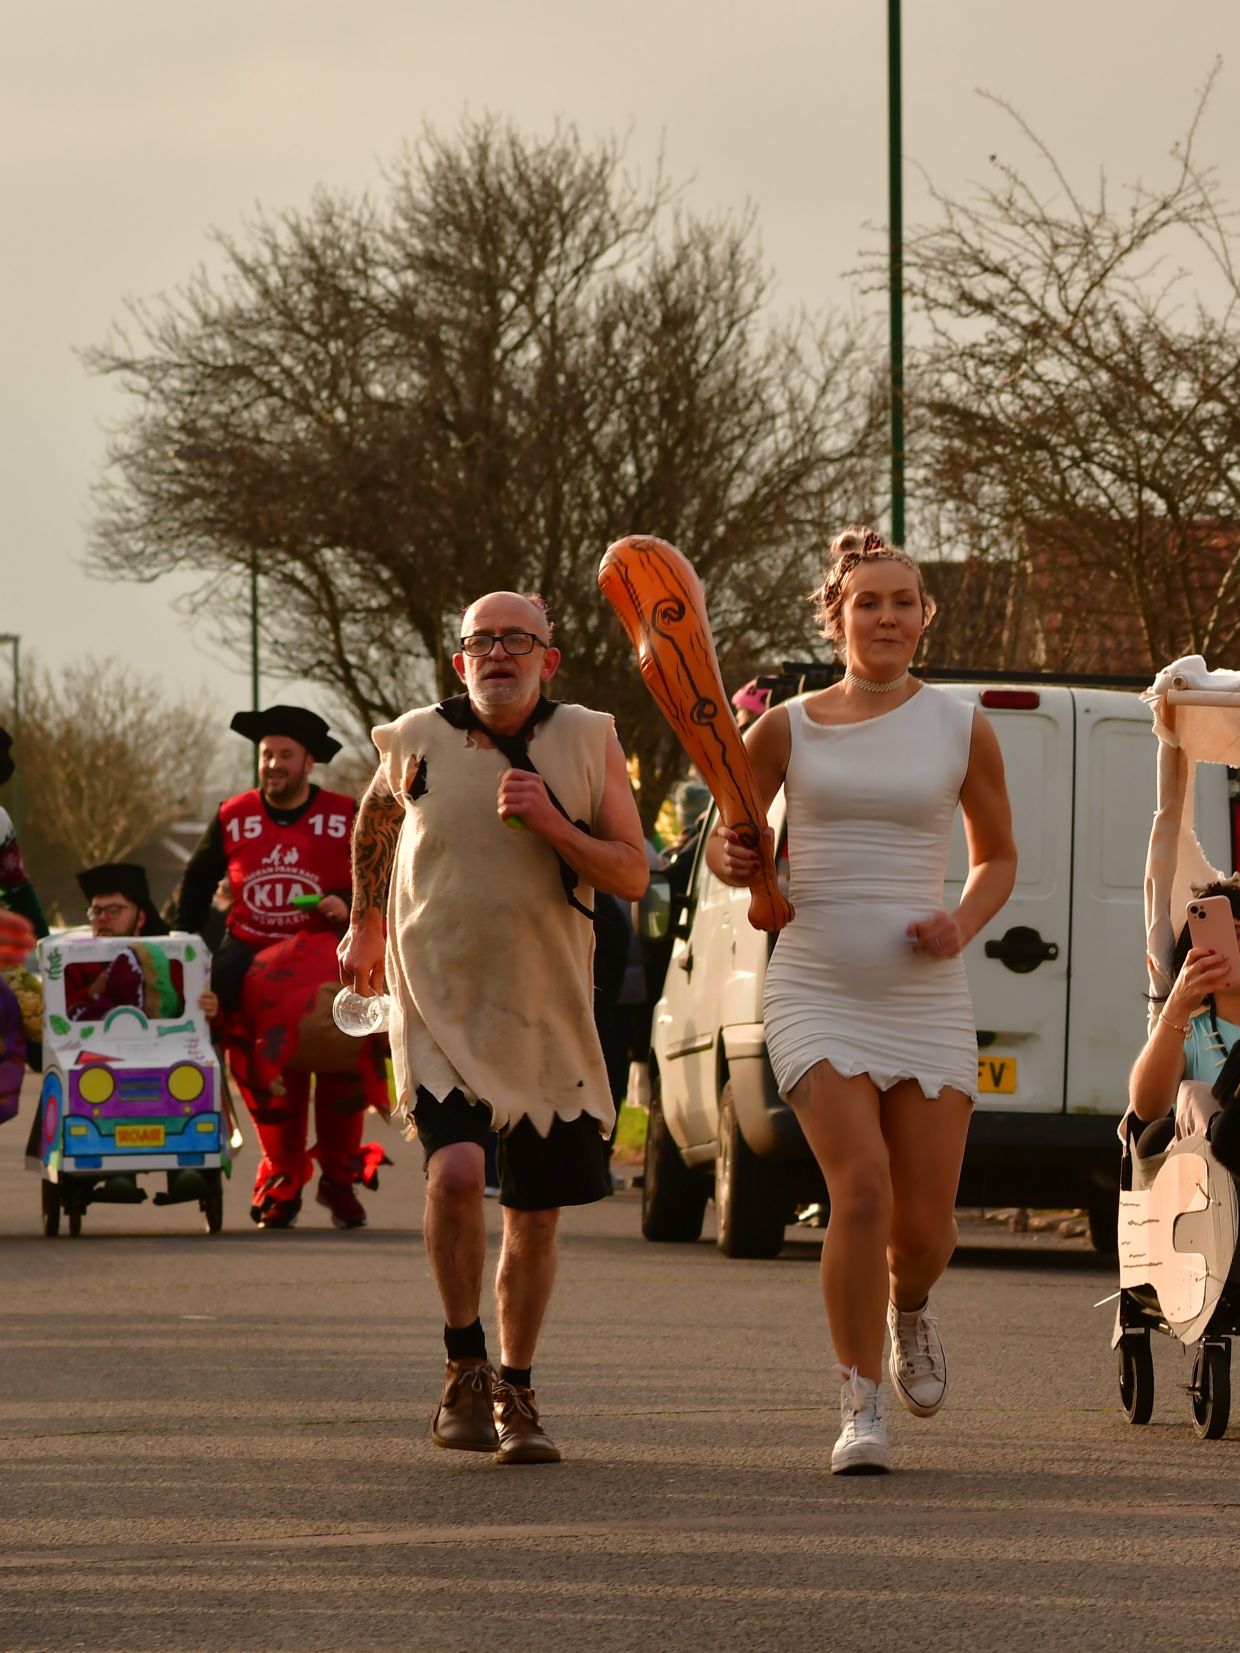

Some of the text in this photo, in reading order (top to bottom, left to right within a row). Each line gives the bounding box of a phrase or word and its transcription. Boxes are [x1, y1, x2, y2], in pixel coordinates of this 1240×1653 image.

[226, 815, 263, 842] 15
[308, 813, 346, 838] 15
[253, 884, 305, 907] KIA
[117, 1128, 161, 1143] ROAR
